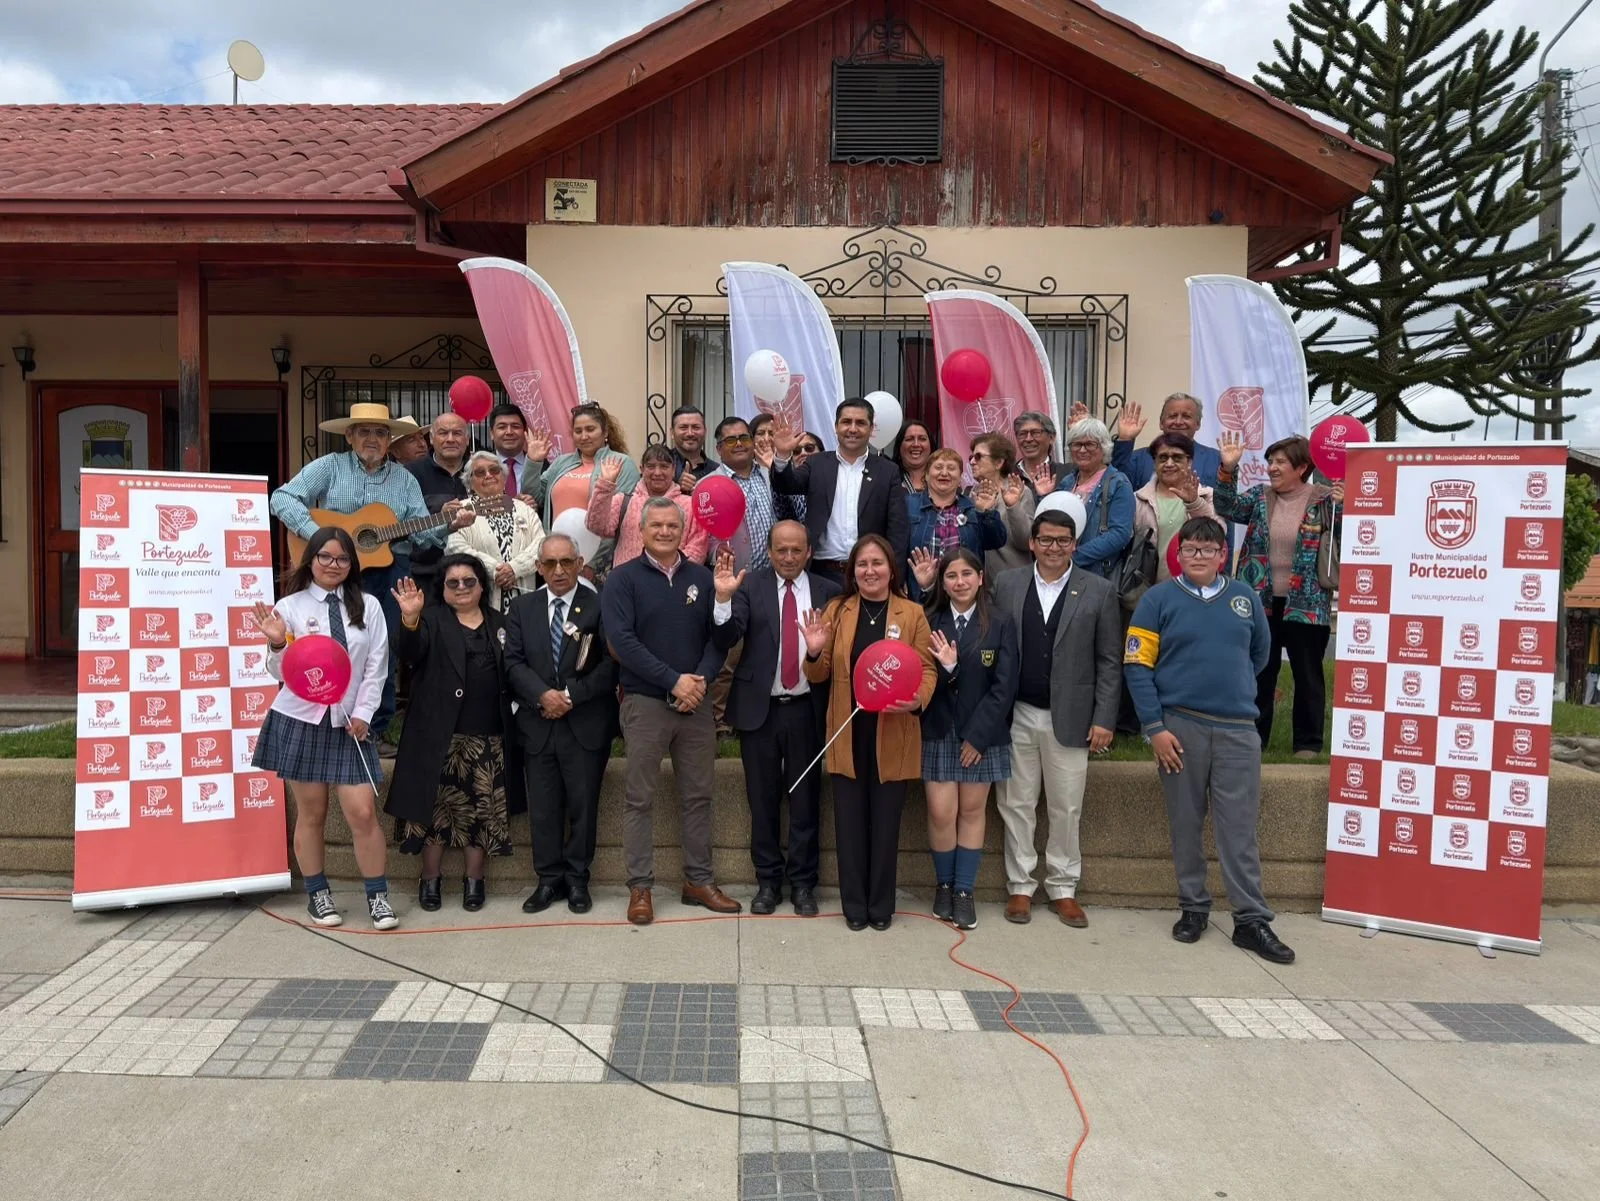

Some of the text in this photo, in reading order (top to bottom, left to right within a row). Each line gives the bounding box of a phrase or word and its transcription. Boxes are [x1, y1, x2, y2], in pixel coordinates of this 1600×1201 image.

[1355, 500, 1382, 508] Portezuelo
[1520, 503, 1552, 511] Portezuelo
[141, 542, 213, 566] Portezuelo
[1436, 553, 1487, 562] Municipalidad
[1517, 553, 1549, 561] Portezuelo
[136, 568, 220, 578] Valle que encanta
[1409, 563, 1488, 580] Portezuelo
[1514, 605, 1545, 613] Portezuelo
[1399, 651, 1428, 659] Portezuelo
[1453, 653, 1484, 662] Portezuelo
[1512, 657, 1542, 666] Portezuelo
[1345, 696, 1372, 704] Portezuelo
[1397, 700, 1425, 708] Portezuelo
[1451, 704, 1481, 712] Portezuelo
[1508, 709, 1540, 717] Portezuelo
[1343, 743, 1370, 752] Portezuelo
[1394, 748, 1423, 757] Portezuelo
[1448, 753, 1478, 762] Portezuelo
[1506, 759, 1536, 768] Portezuelo
[1340, 791, 1368, 800] Portezuelo
[1392, 797, 1420, 806] Portezuelo
[1446, 803, 1476, 812] Portezuelo
[1503, 809, 1534, 819] Portezuelo
[1338, 839, 1365, 847] Portezuelo
[1389, 845, 1418, 854] Portezuelo
[1443, 853, 1473, 861] Portezuelo
[1500, 859, 1531, 869] Portezuelo
